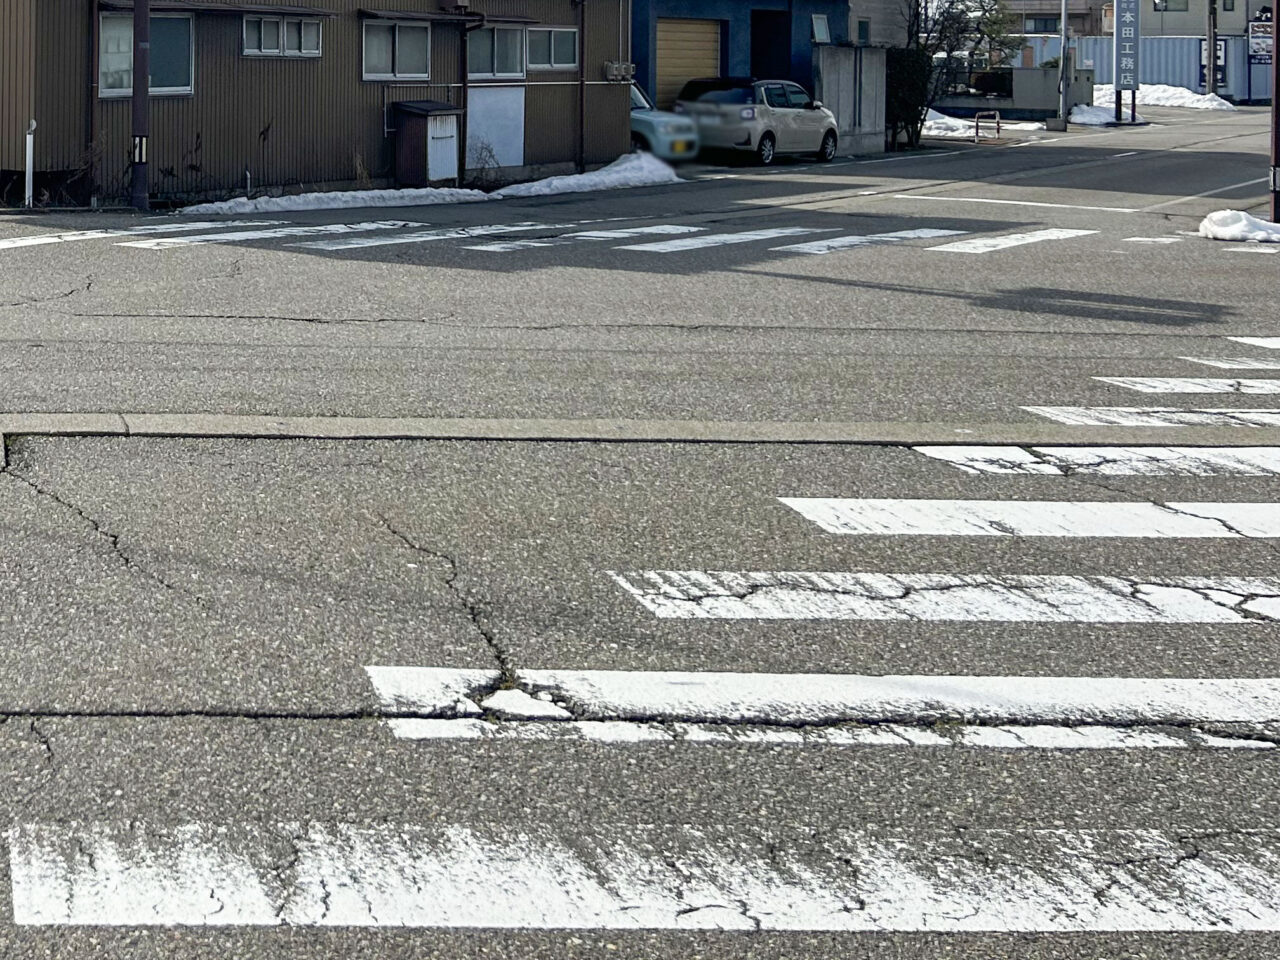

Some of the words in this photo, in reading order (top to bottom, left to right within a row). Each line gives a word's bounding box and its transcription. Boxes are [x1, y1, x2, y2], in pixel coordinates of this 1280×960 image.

[1120, 11, 1135, 85] 本田工務店
